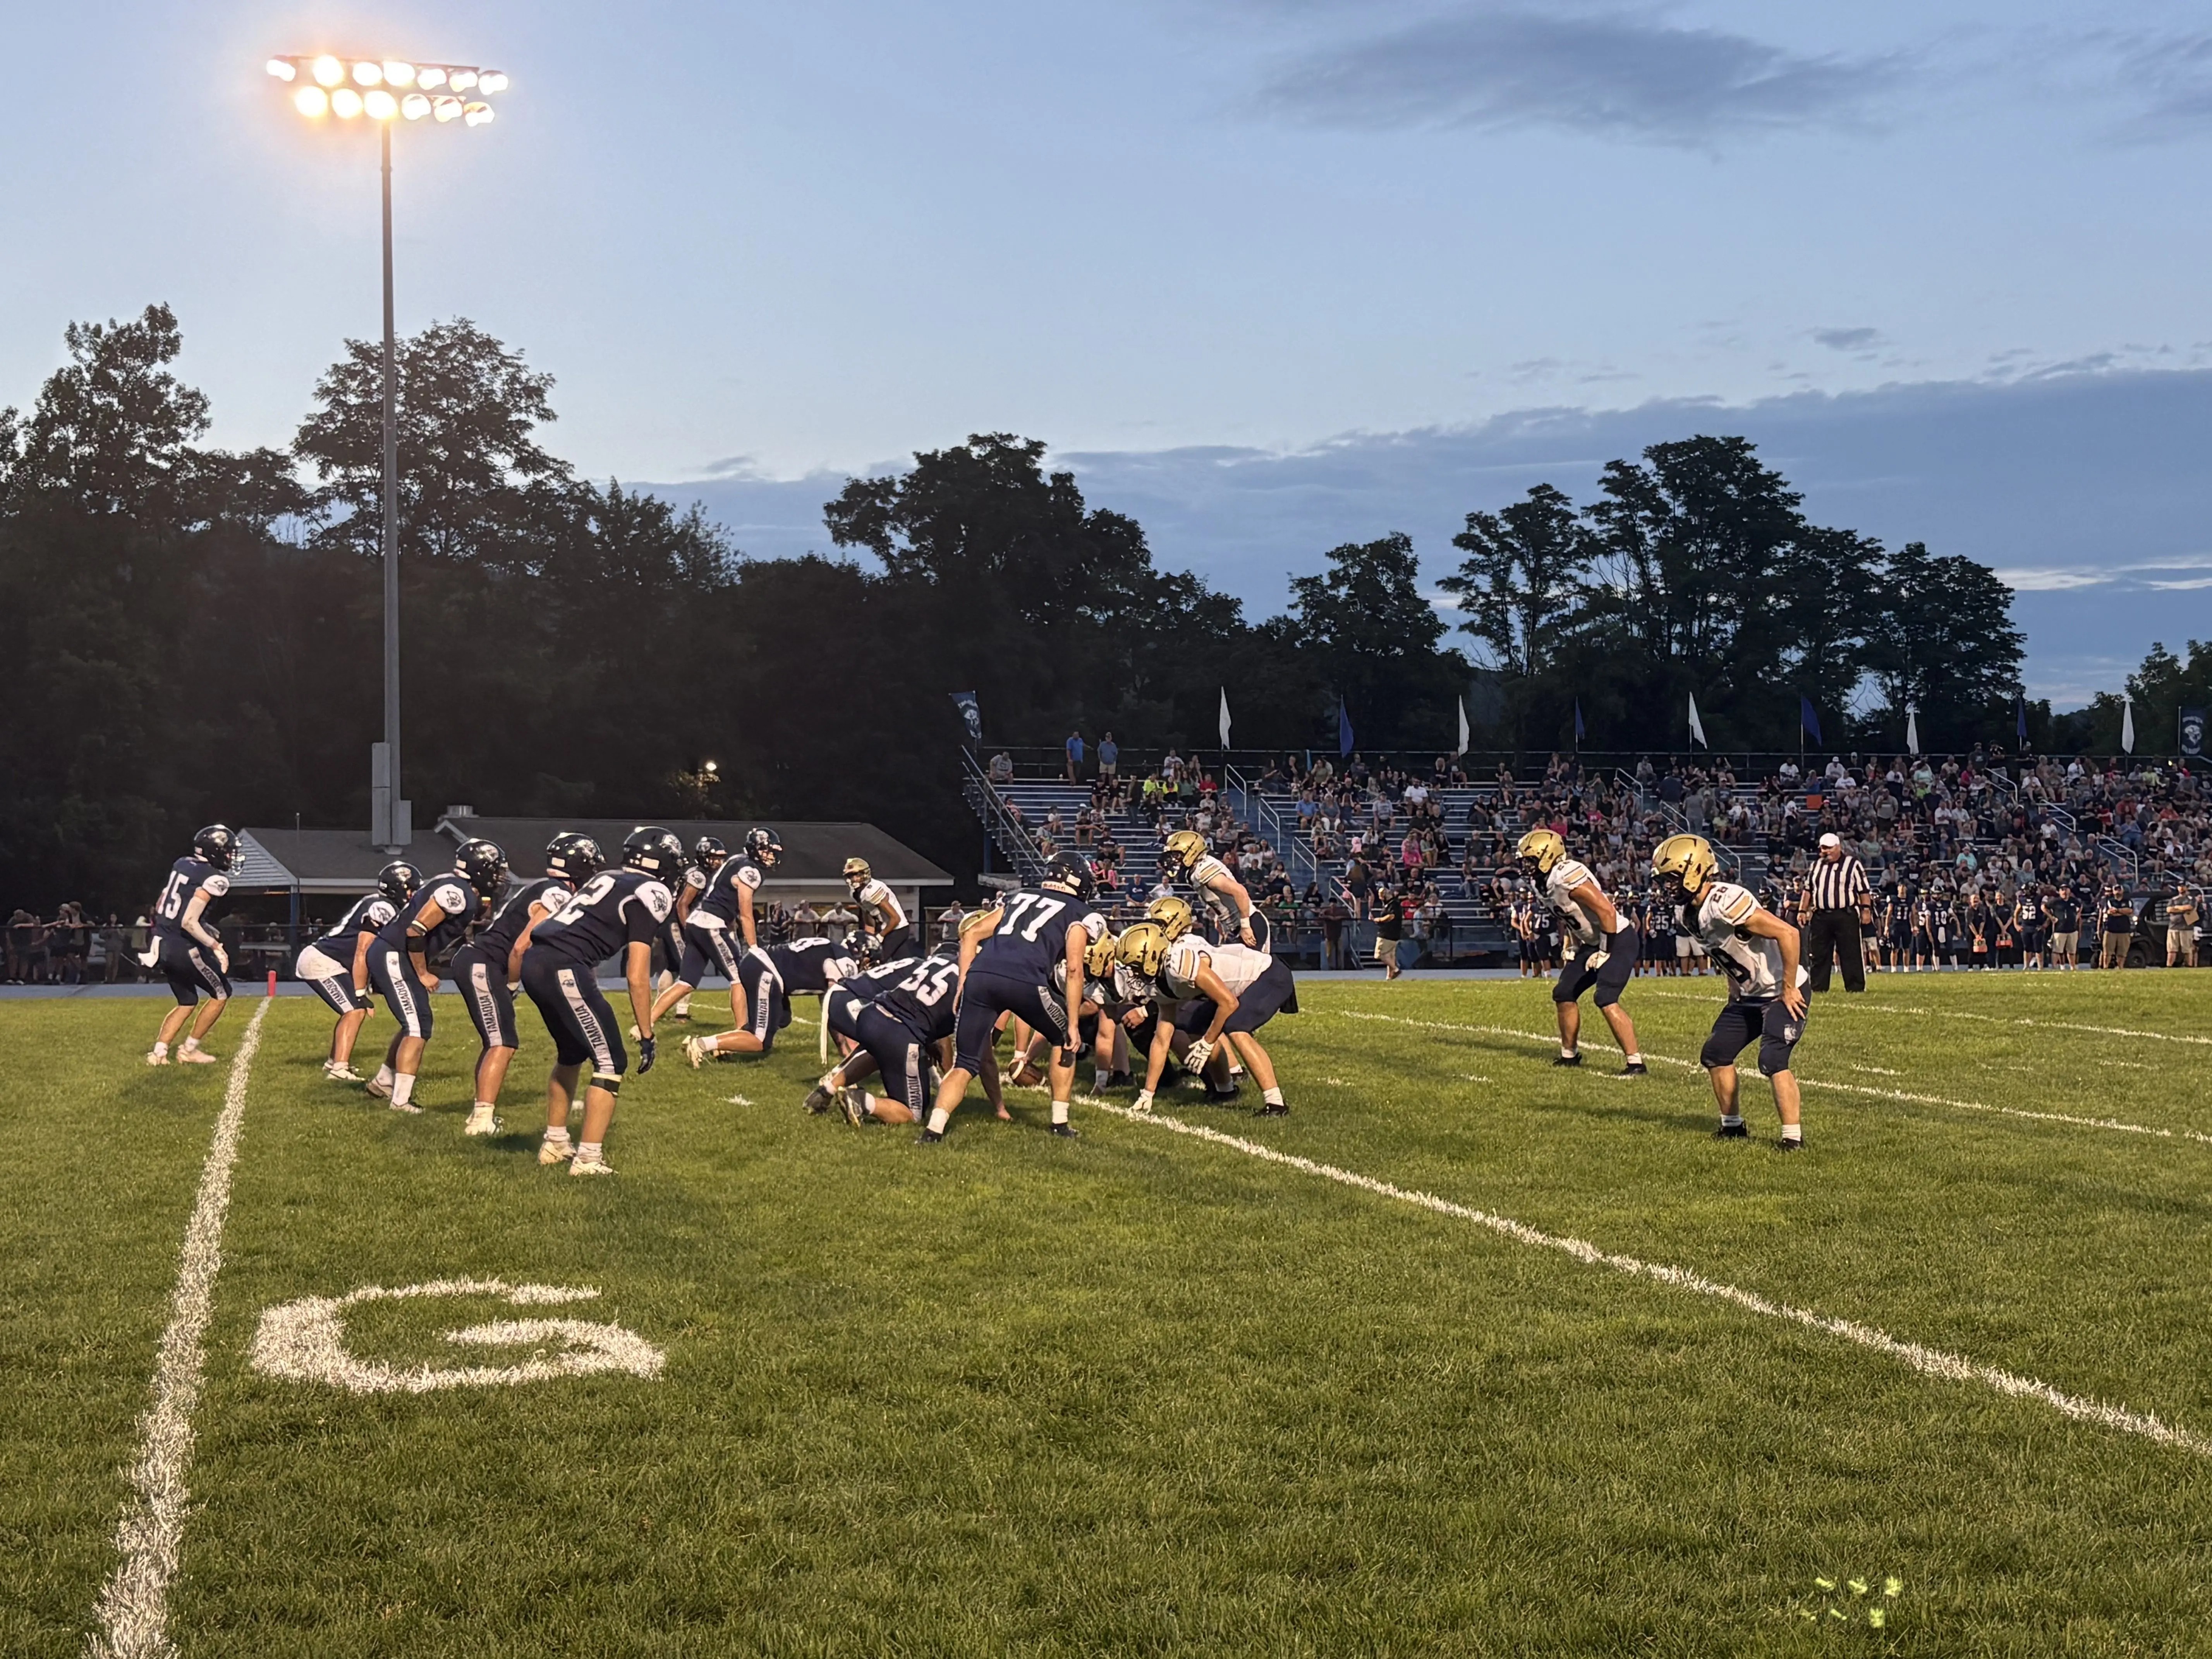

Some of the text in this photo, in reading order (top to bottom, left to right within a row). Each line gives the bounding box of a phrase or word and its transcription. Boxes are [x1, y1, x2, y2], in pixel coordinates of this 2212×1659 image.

[997, 893, 1066, 942] 77
[1535, 913, 1549, 929] 75
[1655, 915, 1669, 930] 25
[1935, 911, 1947, 925] 10
[2022, 905, 2036, 920] 52
[899, 957, 959, 1006] 55
[575, 1004, 605, 1049] TAMAQUA
[251, 1275, 666, 1396] G
